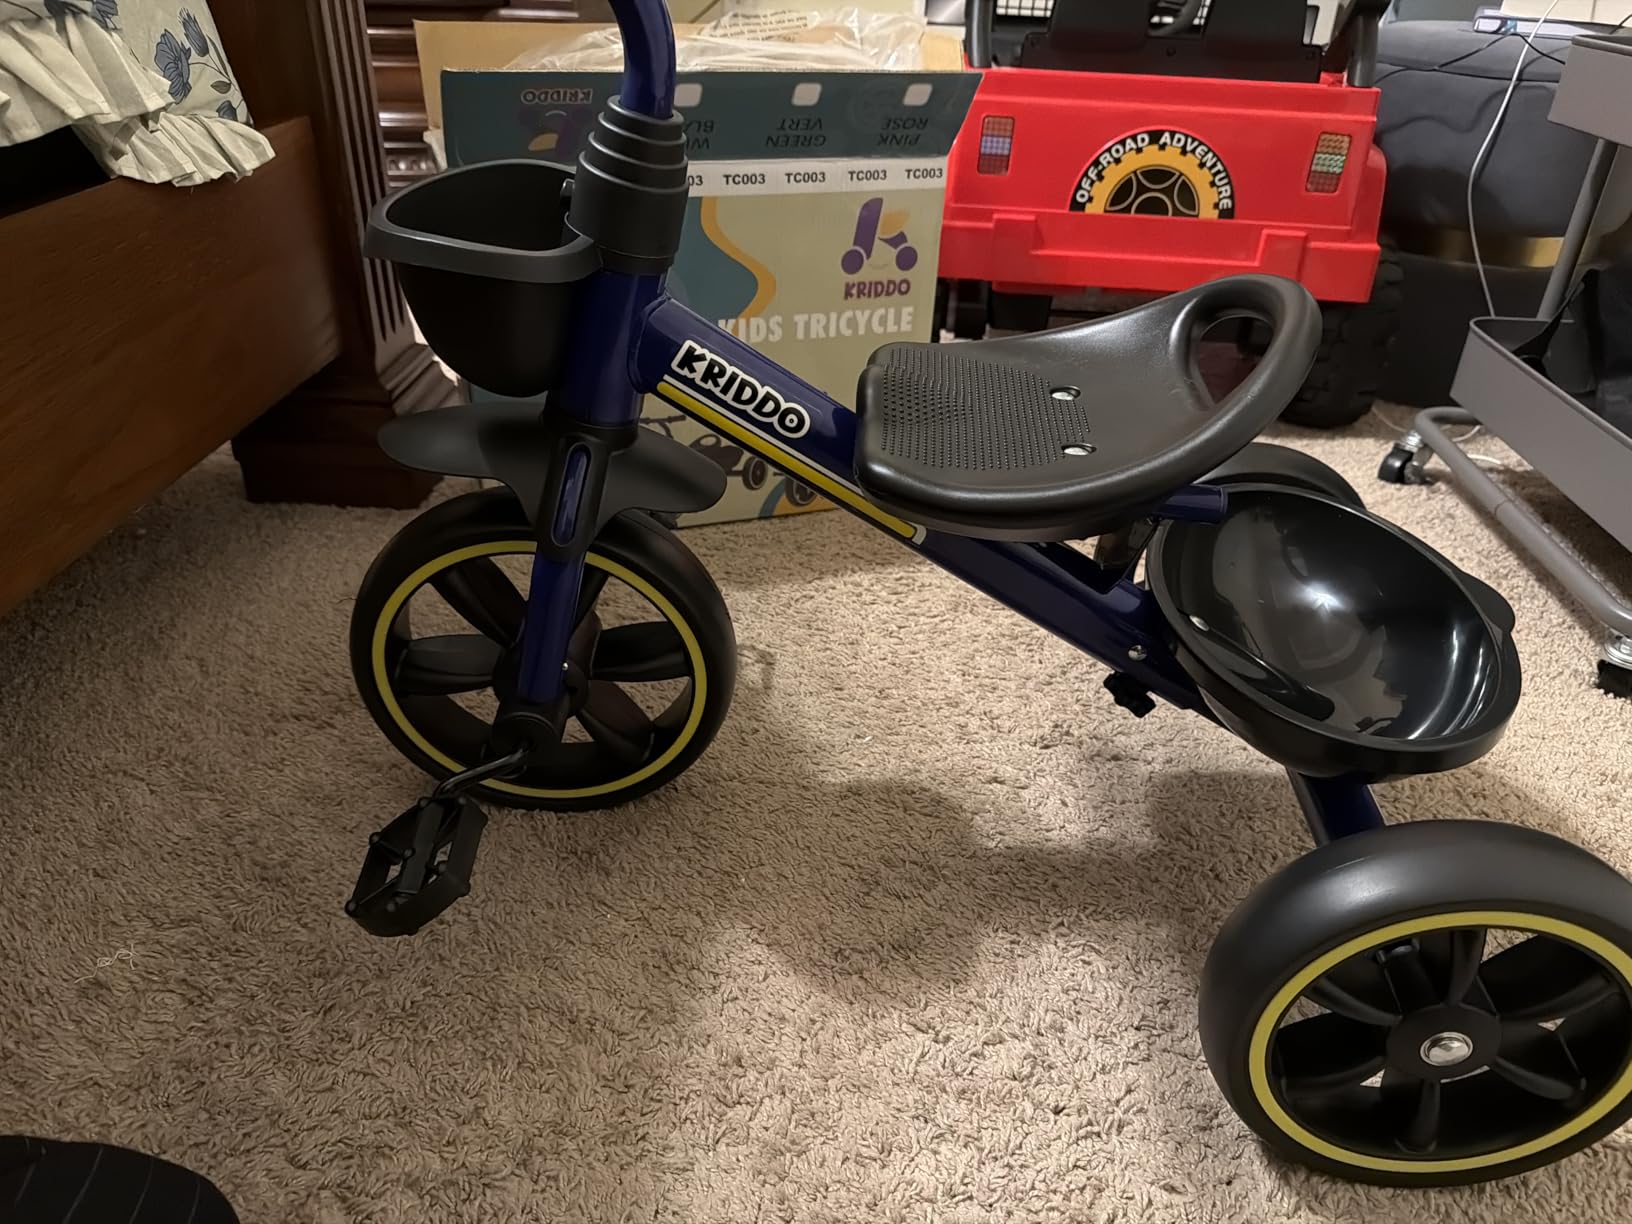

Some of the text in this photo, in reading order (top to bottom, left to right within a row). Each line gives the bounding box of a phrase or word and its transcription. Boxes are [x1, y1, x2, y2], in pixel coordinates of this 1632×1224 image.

[521, 88, 593, 104] KRIDDO
[777, 118, 823, 131] VERT
[882, 117, 928, 130] ROSE
[765, 134, 827, 148] GREEN
[877, 133, 921, 147] PINK
[722, 167, 943, 186] TC003 TC003 TC003 TC003
[1075, 131, 1232, 210] OFF-ROAD ADVENTURE
[844, 278, 911, 300] KRIDDO
[794, 306, 914, 340] TRICYCLE
[671, 340, 810, 438] KRIDDO
